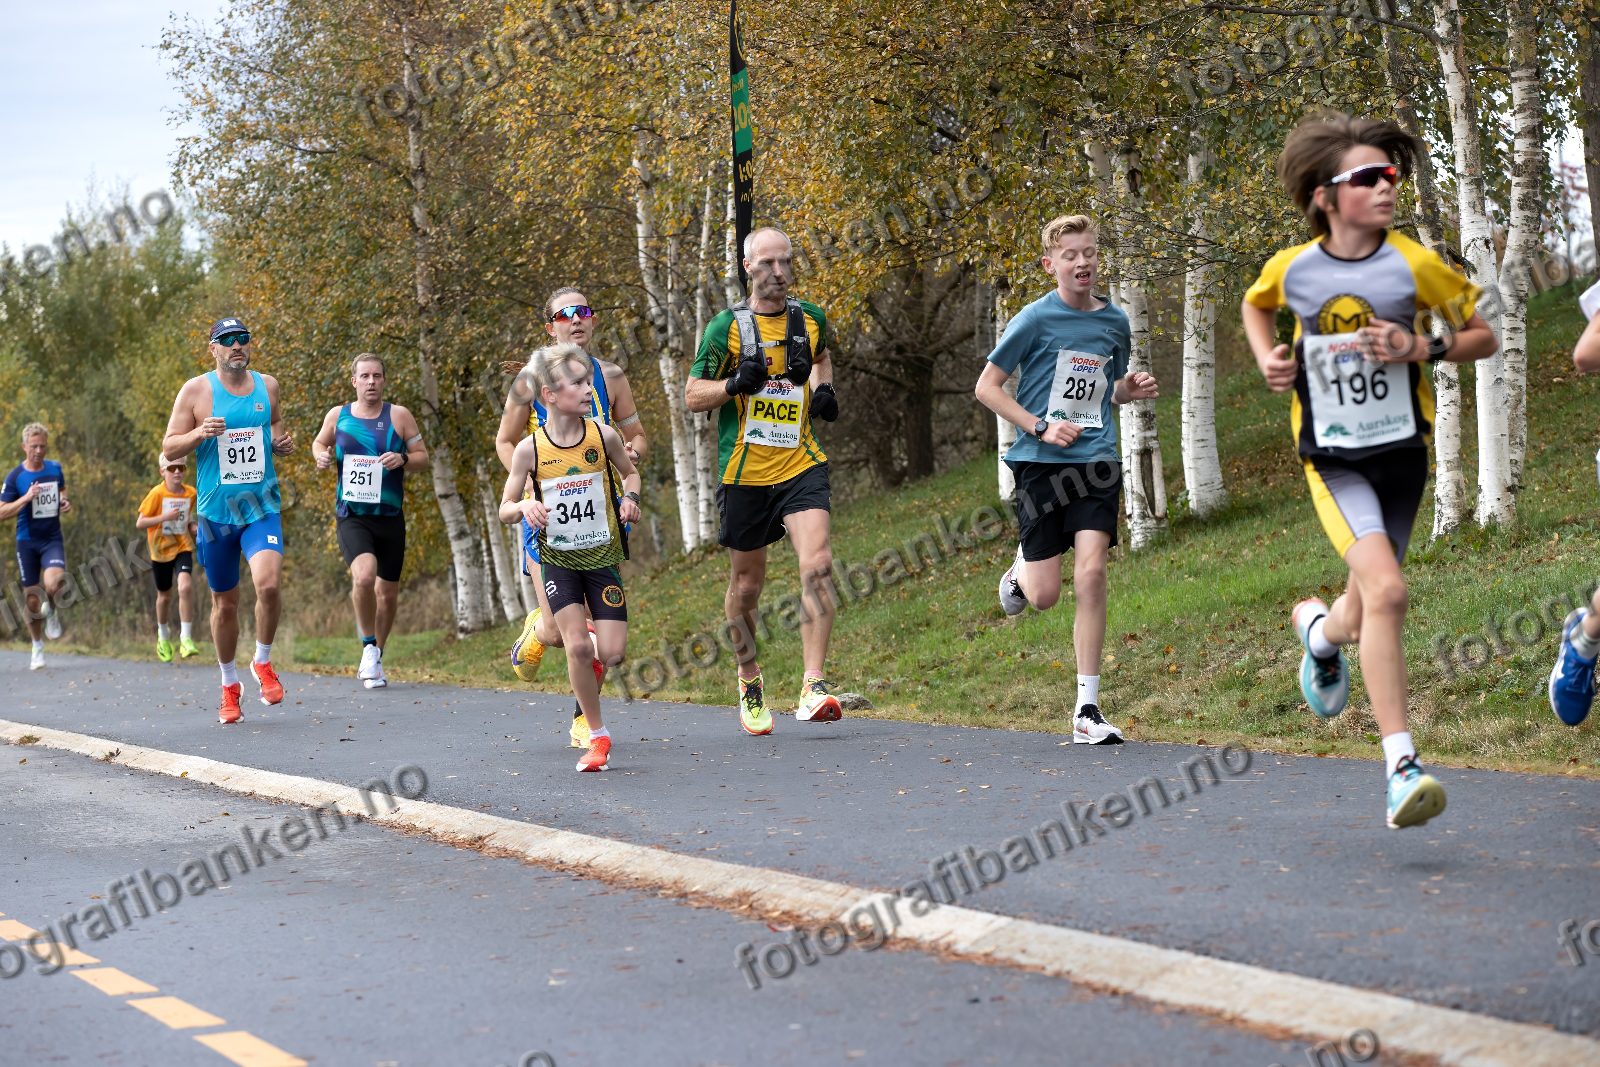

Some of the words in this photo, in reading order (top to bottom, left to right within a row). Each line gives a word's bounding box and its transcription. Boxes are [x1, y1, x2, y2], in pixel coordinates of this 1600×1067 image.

[1071, 356, 1101, 368] NORGE
[1072, 364, 1099, 374] LØPET
[766, 387, 792, 396] LØPET
[1062, 376, 1097, 402] 281
[1331, 369, 1389, 405] 196
[753, 400, 798, 422] PACE
[768, 430, 798, 441] Aurskog
[227, 446, 257, 465] 912
[349, 470, 373, 486] 251
[556, 478, 593, 490] NORGES
[560, 486, 589, 497] LØPET
[35, 493, 57, 506] 1004
[556, 499, 595, 525] 344
[573, 530, 609, 542] Aurskog
